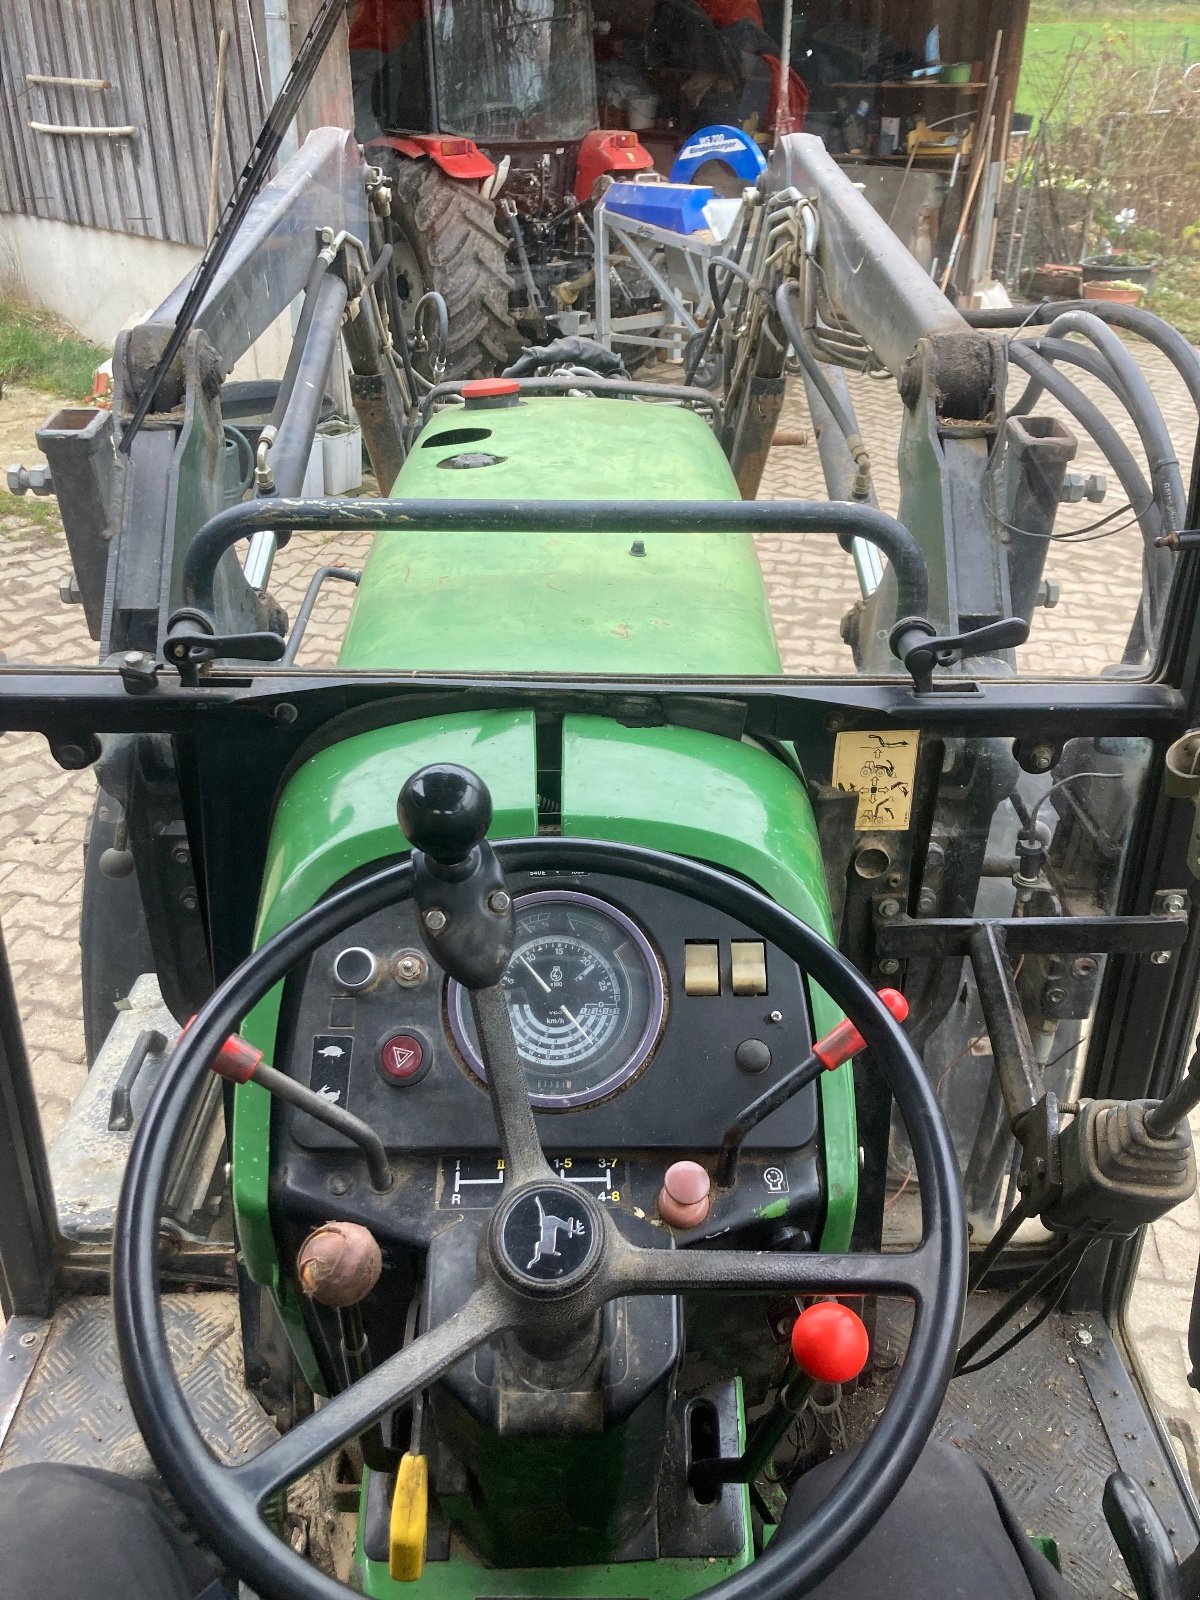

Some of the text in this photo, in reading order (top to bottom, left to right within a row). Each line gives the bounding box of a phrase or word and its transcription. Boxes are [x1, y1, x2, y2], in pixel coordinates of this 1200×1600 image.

[554, 947, 564, 955] 15
[526, 954, 536, 964] 10
[580, 956, 591, 967] 20
[598, 981, 608, 991] 25
[553, 1158, 573, 1168] 1-5
[598, 1158, 618, 1168] 3-7
[451, 1194, 461, 1205] R
[597, 1191, 621, 1202] 4-8
